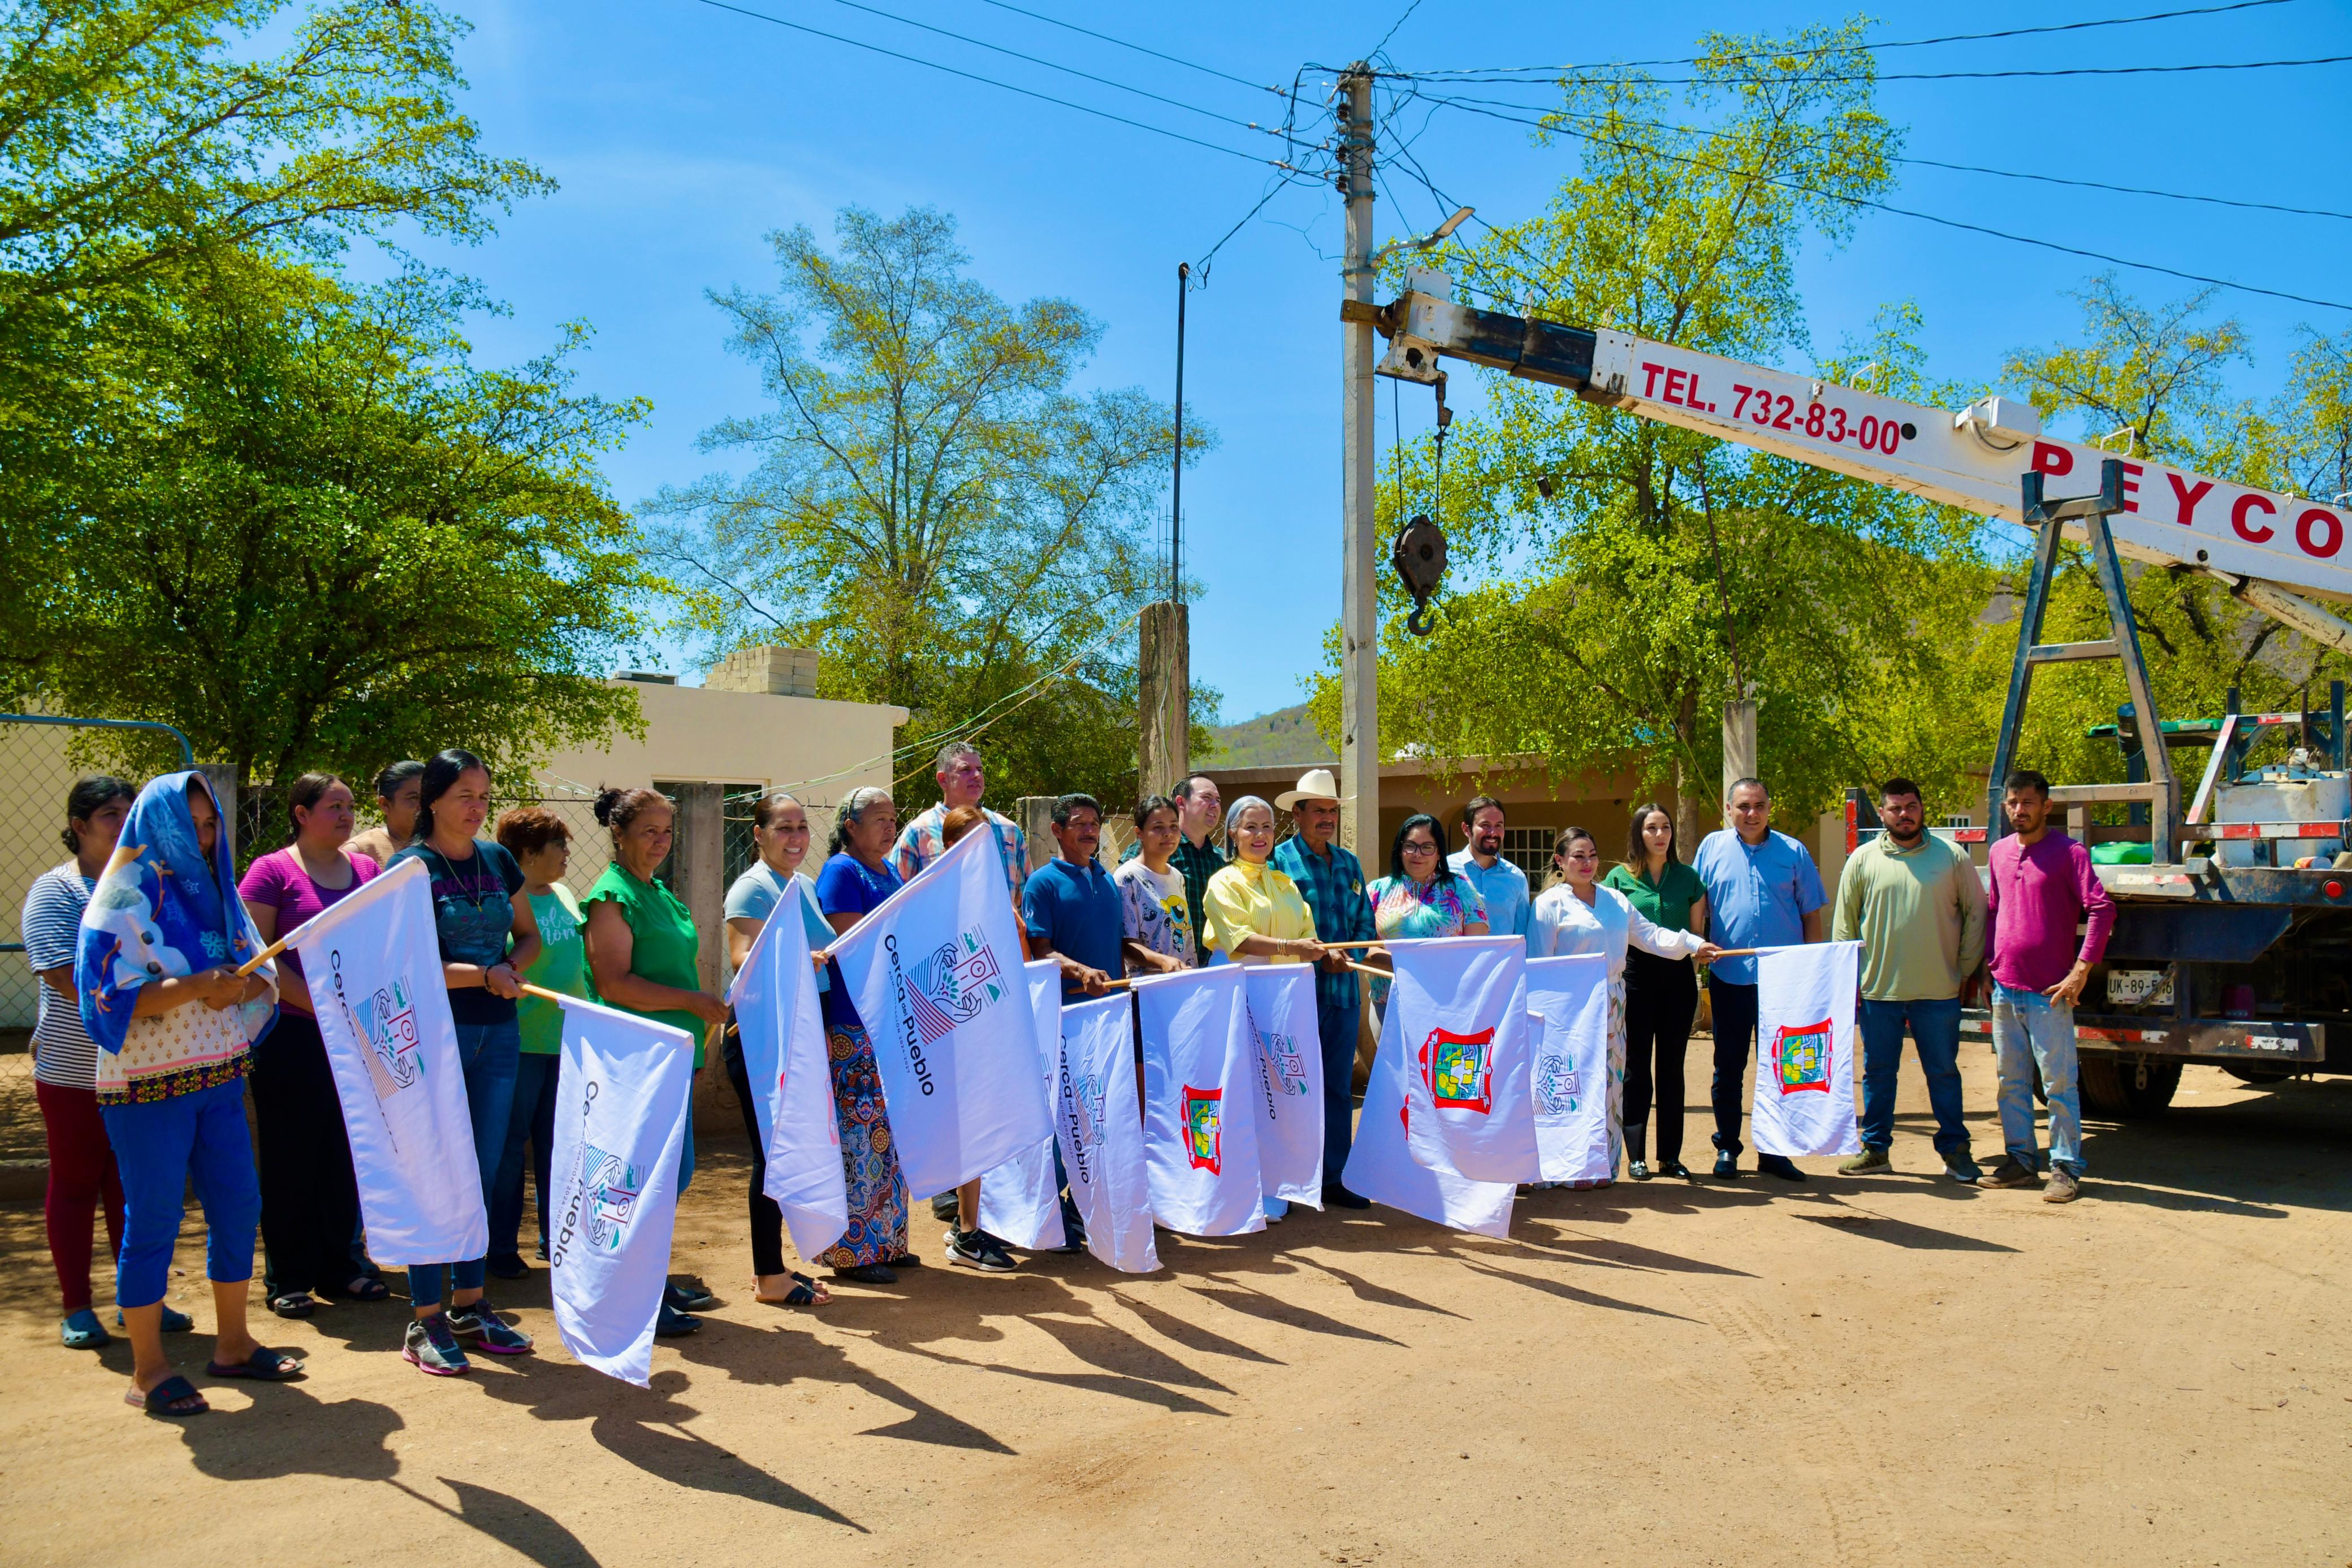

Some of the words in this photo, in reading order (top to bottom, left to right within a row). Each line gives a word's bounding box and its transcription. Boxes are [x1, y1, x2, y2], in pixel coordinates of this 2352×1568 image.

[1642, 362, 1715, 412] TEL.
[1733, 384, 1900, 455] 732-83-00
[2031, 441, 2344, 558] PEYCO
[884, 934, 906, 1003] Cerca
[902, 1015, 934, 1096] Pueblo
[1260, 1057, 1276, 1120] Pueblo
[1069, 1114, 1089, 1184] Pueblo
[553, 1179, 583, 1268] Pueblo
